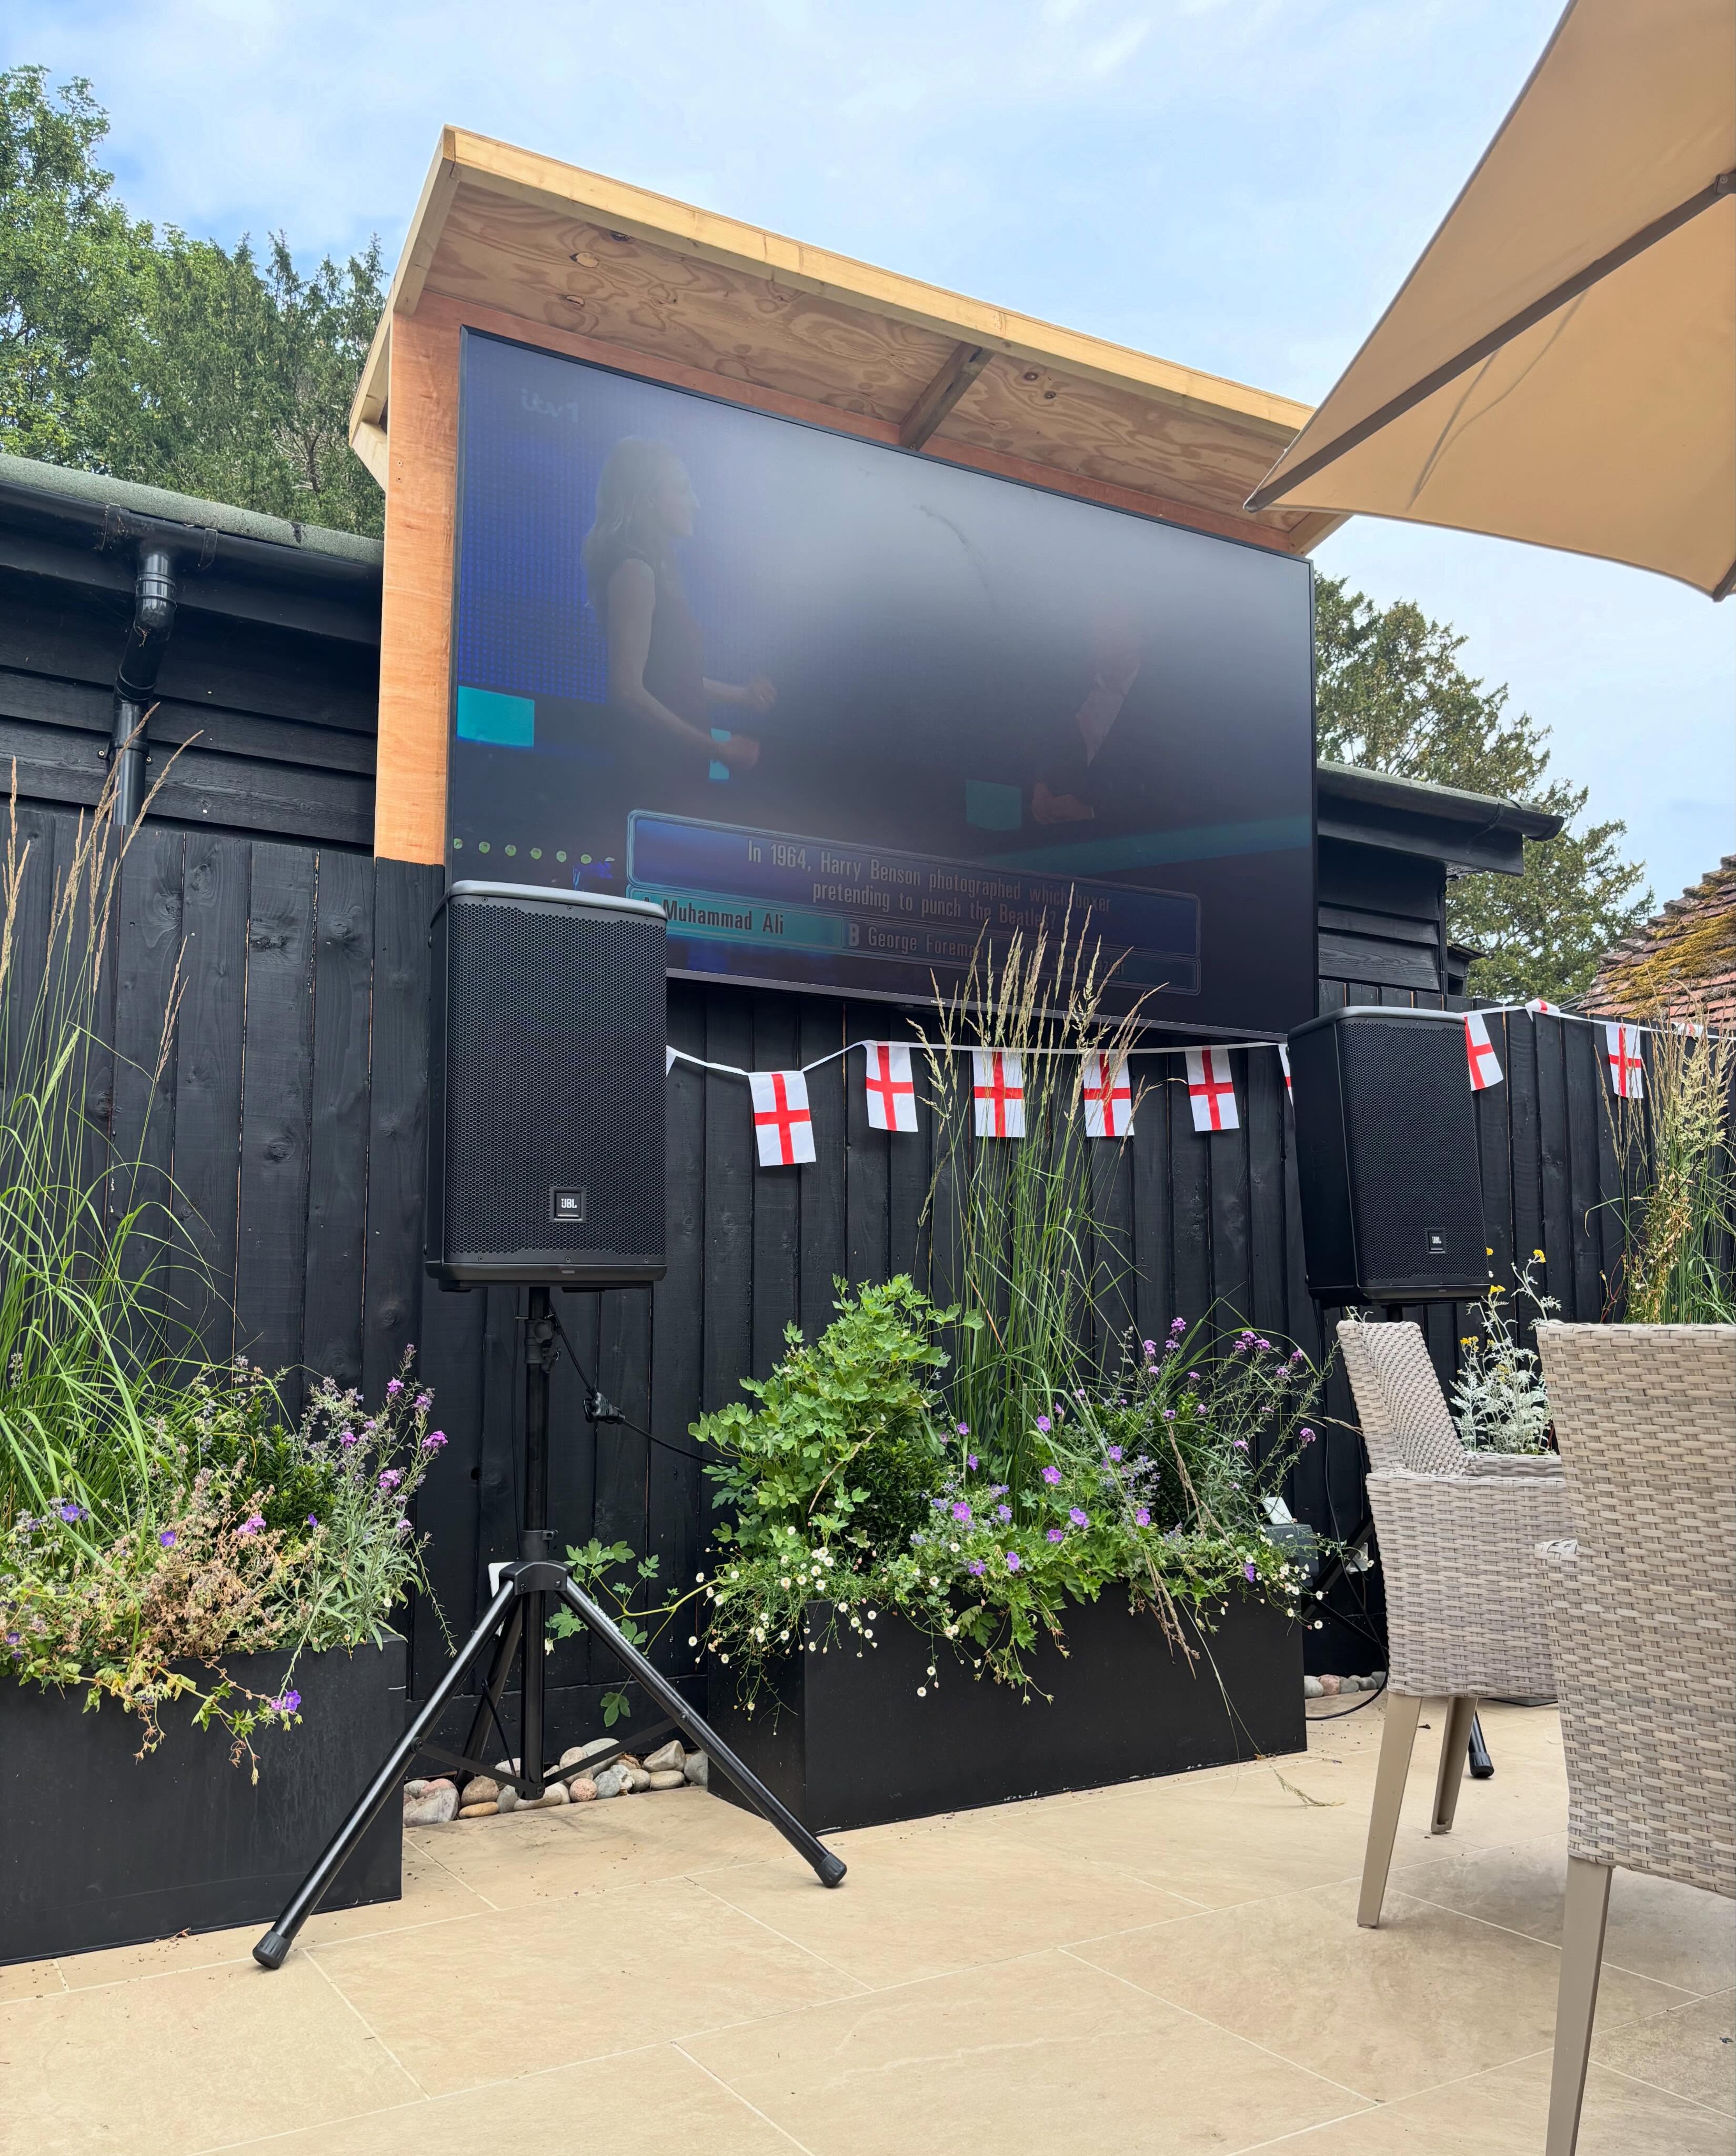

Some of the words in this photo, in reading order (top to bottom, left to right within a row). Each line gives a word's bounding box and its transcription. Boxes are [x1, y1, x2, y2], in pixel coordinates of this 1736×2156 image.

[748, 840, 761, 863] In
[770, 843, 811, 872] 1964,
[820, 851, 861, 882] Harry
[870, 859, 921, 886] Benson
[929, 867, 1021, 900] photographed
[1029, 884, 1067, 906] which
[1075, 891, 1111, 912] boxer
[663, 899, 752, 931] Muhammad
[762, 913, 784, 934] Ali
[813, 883, 889, 912] pretending
[899, 893, 913, 911] to
[921, 897, 961, 917] punch
[970, 901, 991, 921] the
[848, 923, 859, 947] B
[868, 925, 917, 954] George
[561, 1198, 577, 1209] JBL
